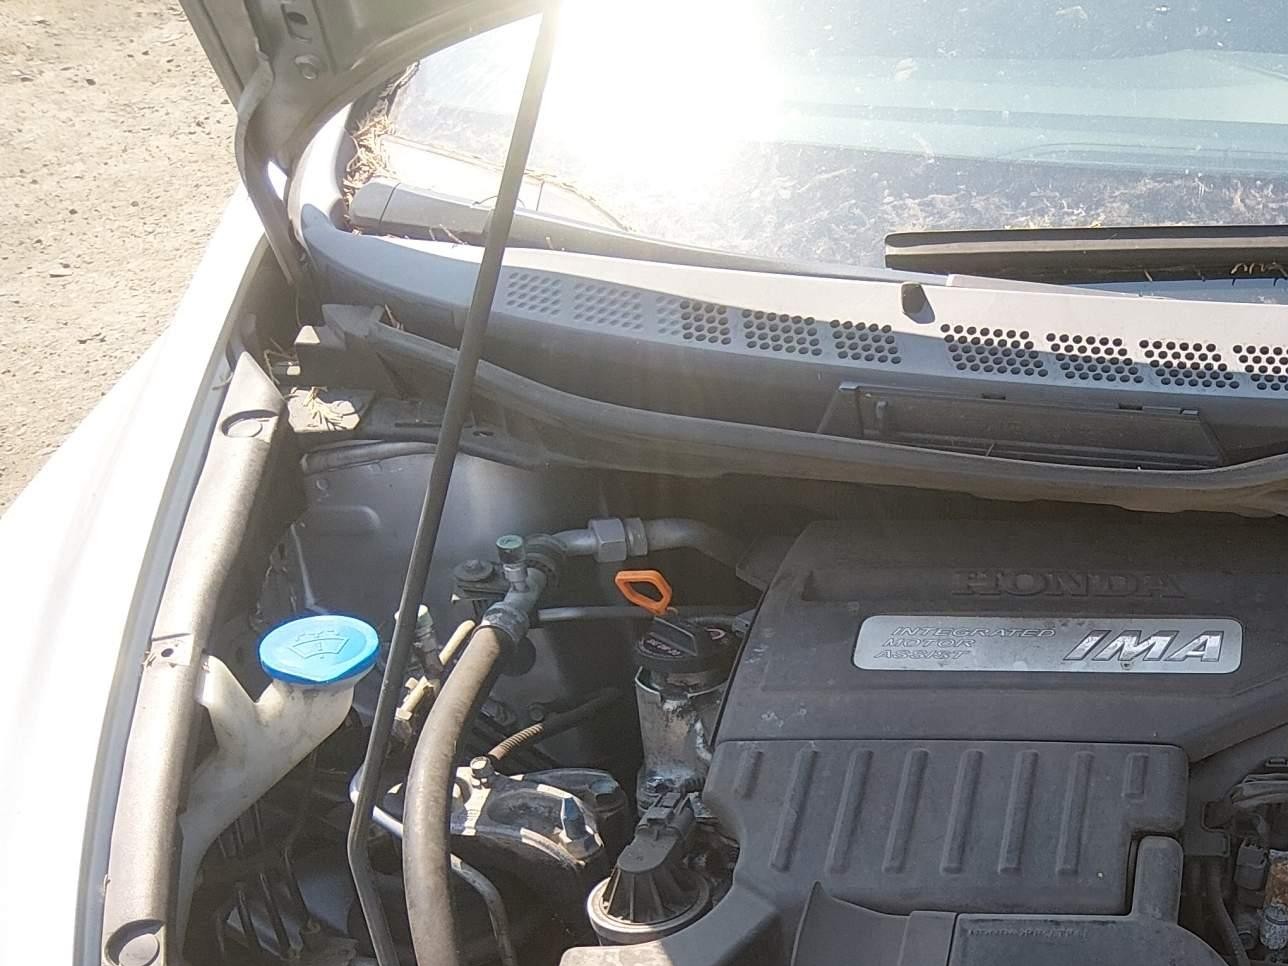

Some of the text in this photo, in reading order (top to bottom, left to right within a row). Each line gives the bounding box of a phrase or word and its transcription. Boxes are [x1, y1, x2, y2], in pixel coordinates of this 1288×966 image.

[952, 568, 1185, 598] HONDA
[891, 626, 1057, 638] INTEGRATED
[882, 638, 976, 648] MOTOR
[1063, 629, 1225, 663] IMA
[874, 649, 972, 660] ASSIST
